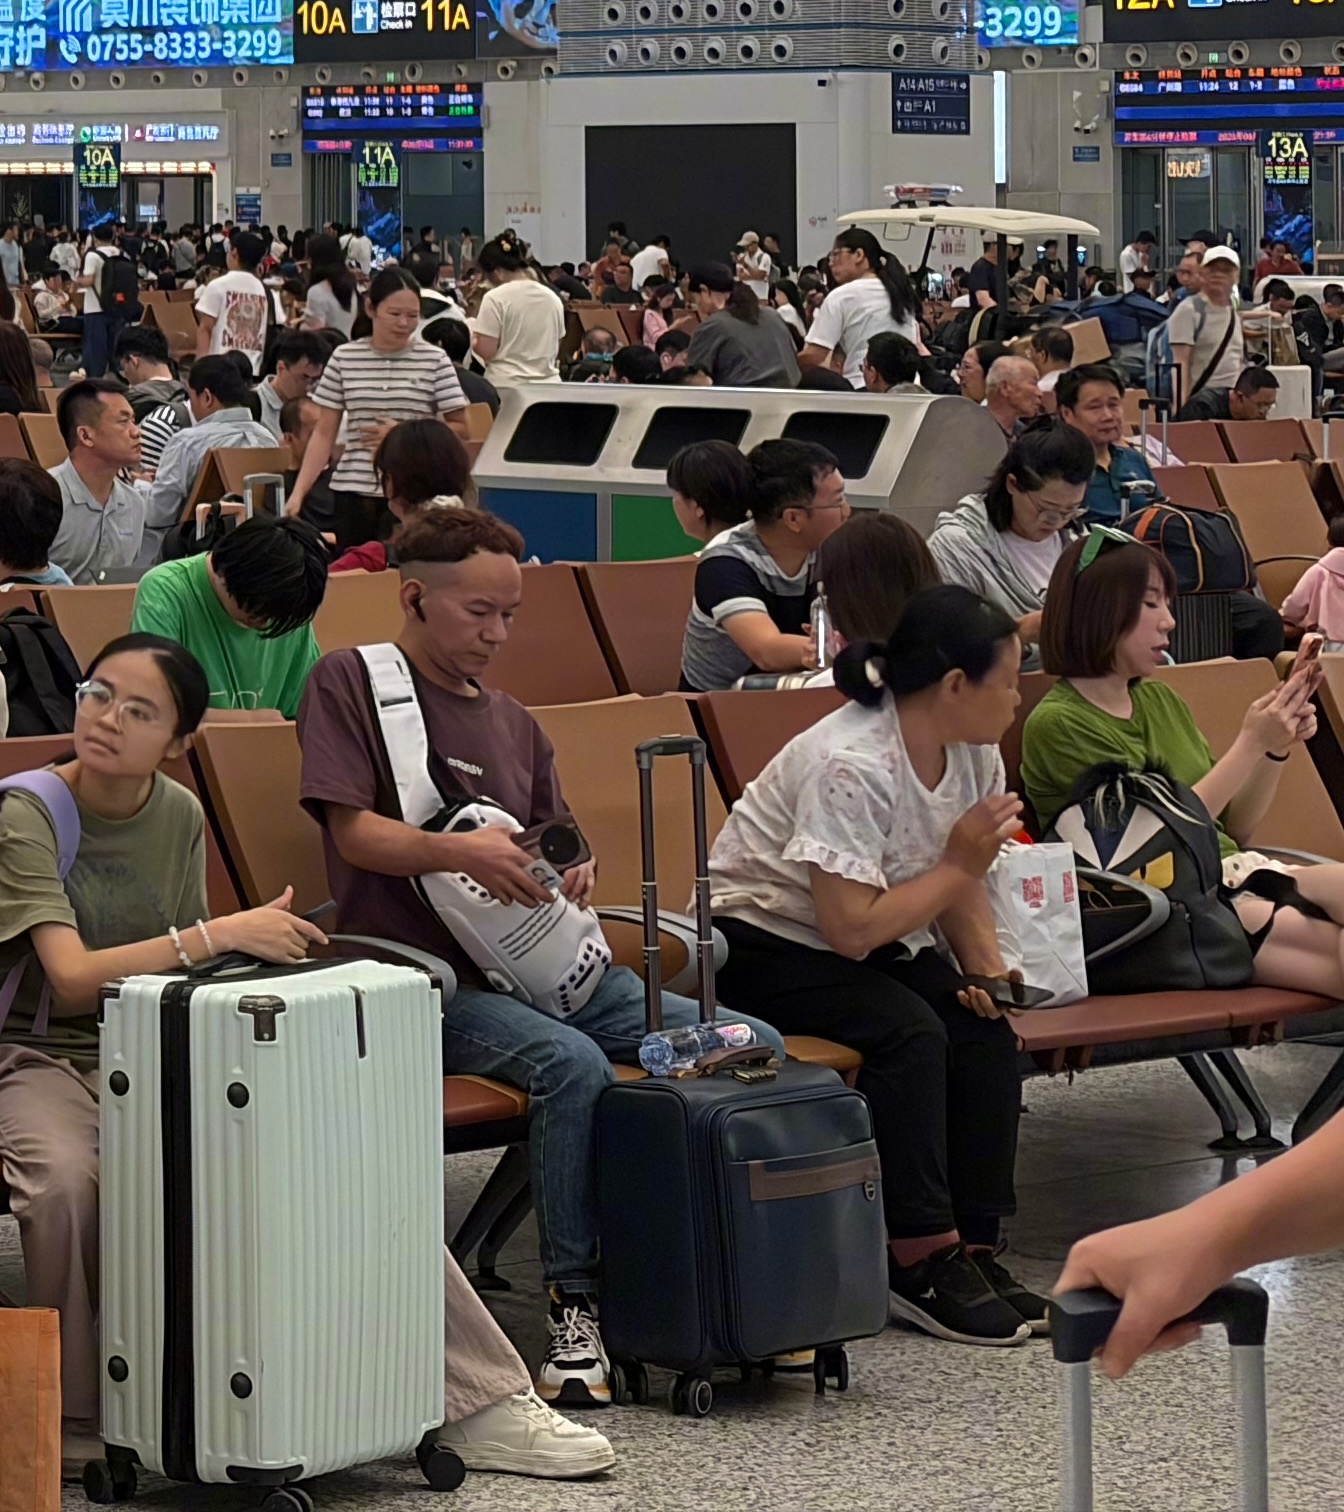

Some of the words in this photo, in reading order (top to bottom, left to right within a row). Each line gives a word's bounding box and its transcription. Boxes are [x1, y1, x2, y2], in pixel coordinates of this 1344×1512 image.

[297, 0, 347, 35] 10A
[381, 1, 416, 19] 检票口
[86, 28, 281, 63] 0755-8333-3299
[83, 149, 115, 167] 10A
[362, 146, 396, 165] 11A
[1267, 137, 1309, 159] 13A
